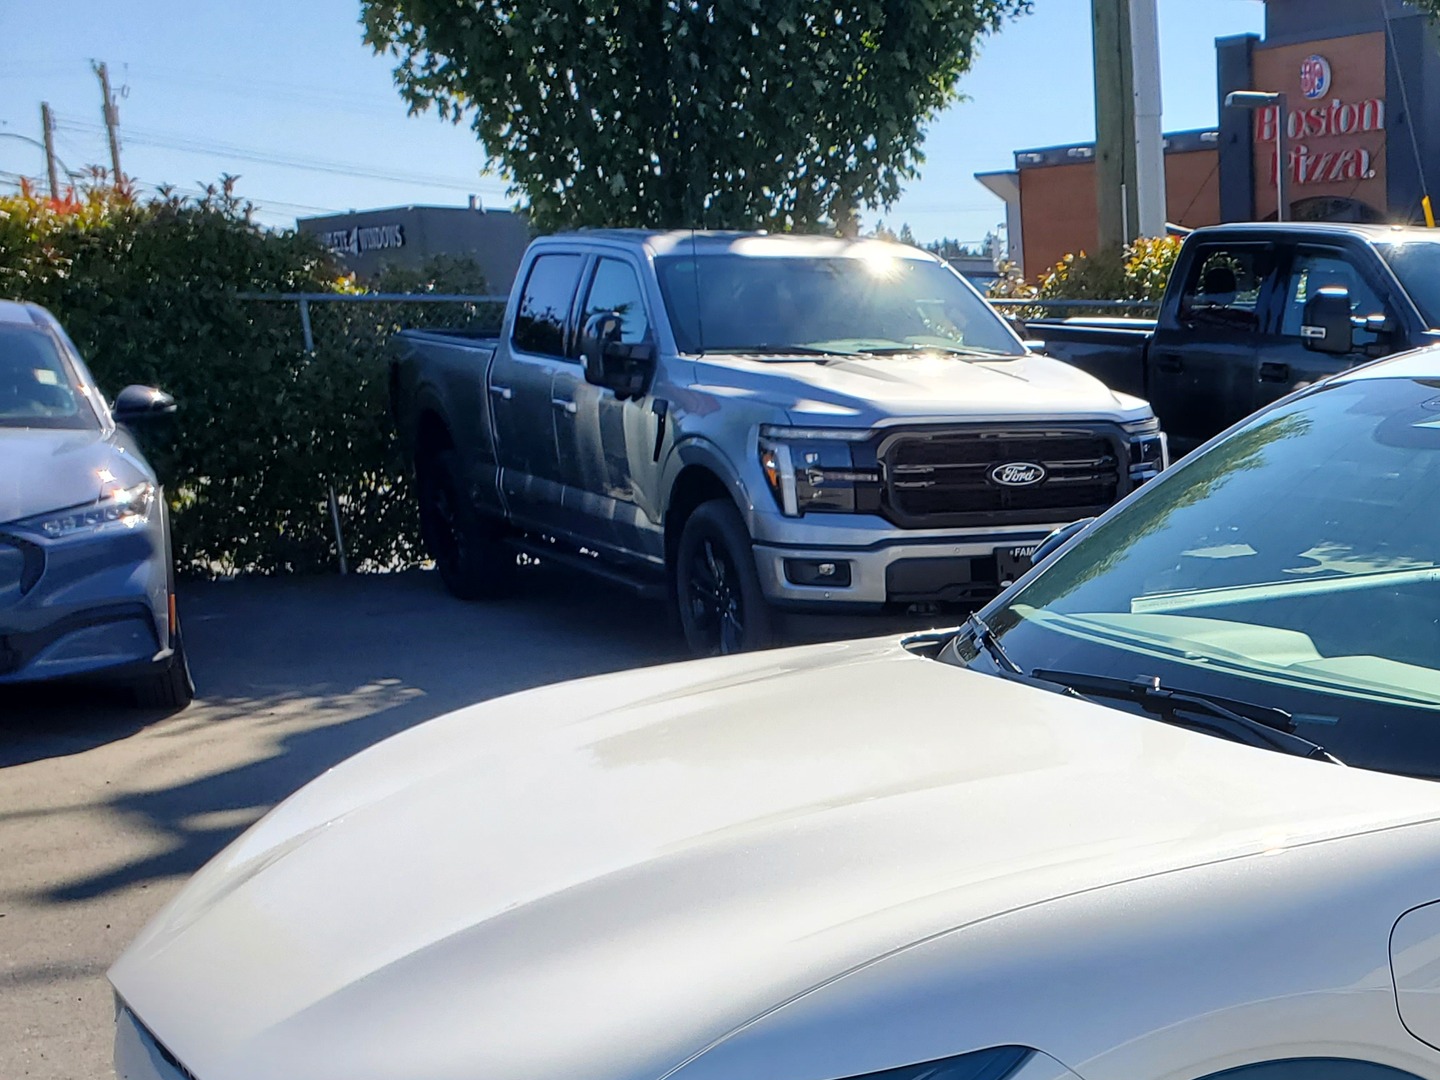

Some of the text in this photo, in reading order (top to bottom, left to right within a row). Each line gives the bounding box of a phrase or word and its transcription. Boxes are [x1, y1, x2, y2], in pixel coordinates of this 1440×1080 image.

[1256, 98, 1384, 142] Boston
[359, 225, 402, 250] WINDOWS
[1002, 466, 1035, 482] Ford
[1014, 546, 1036, 558] FAM
